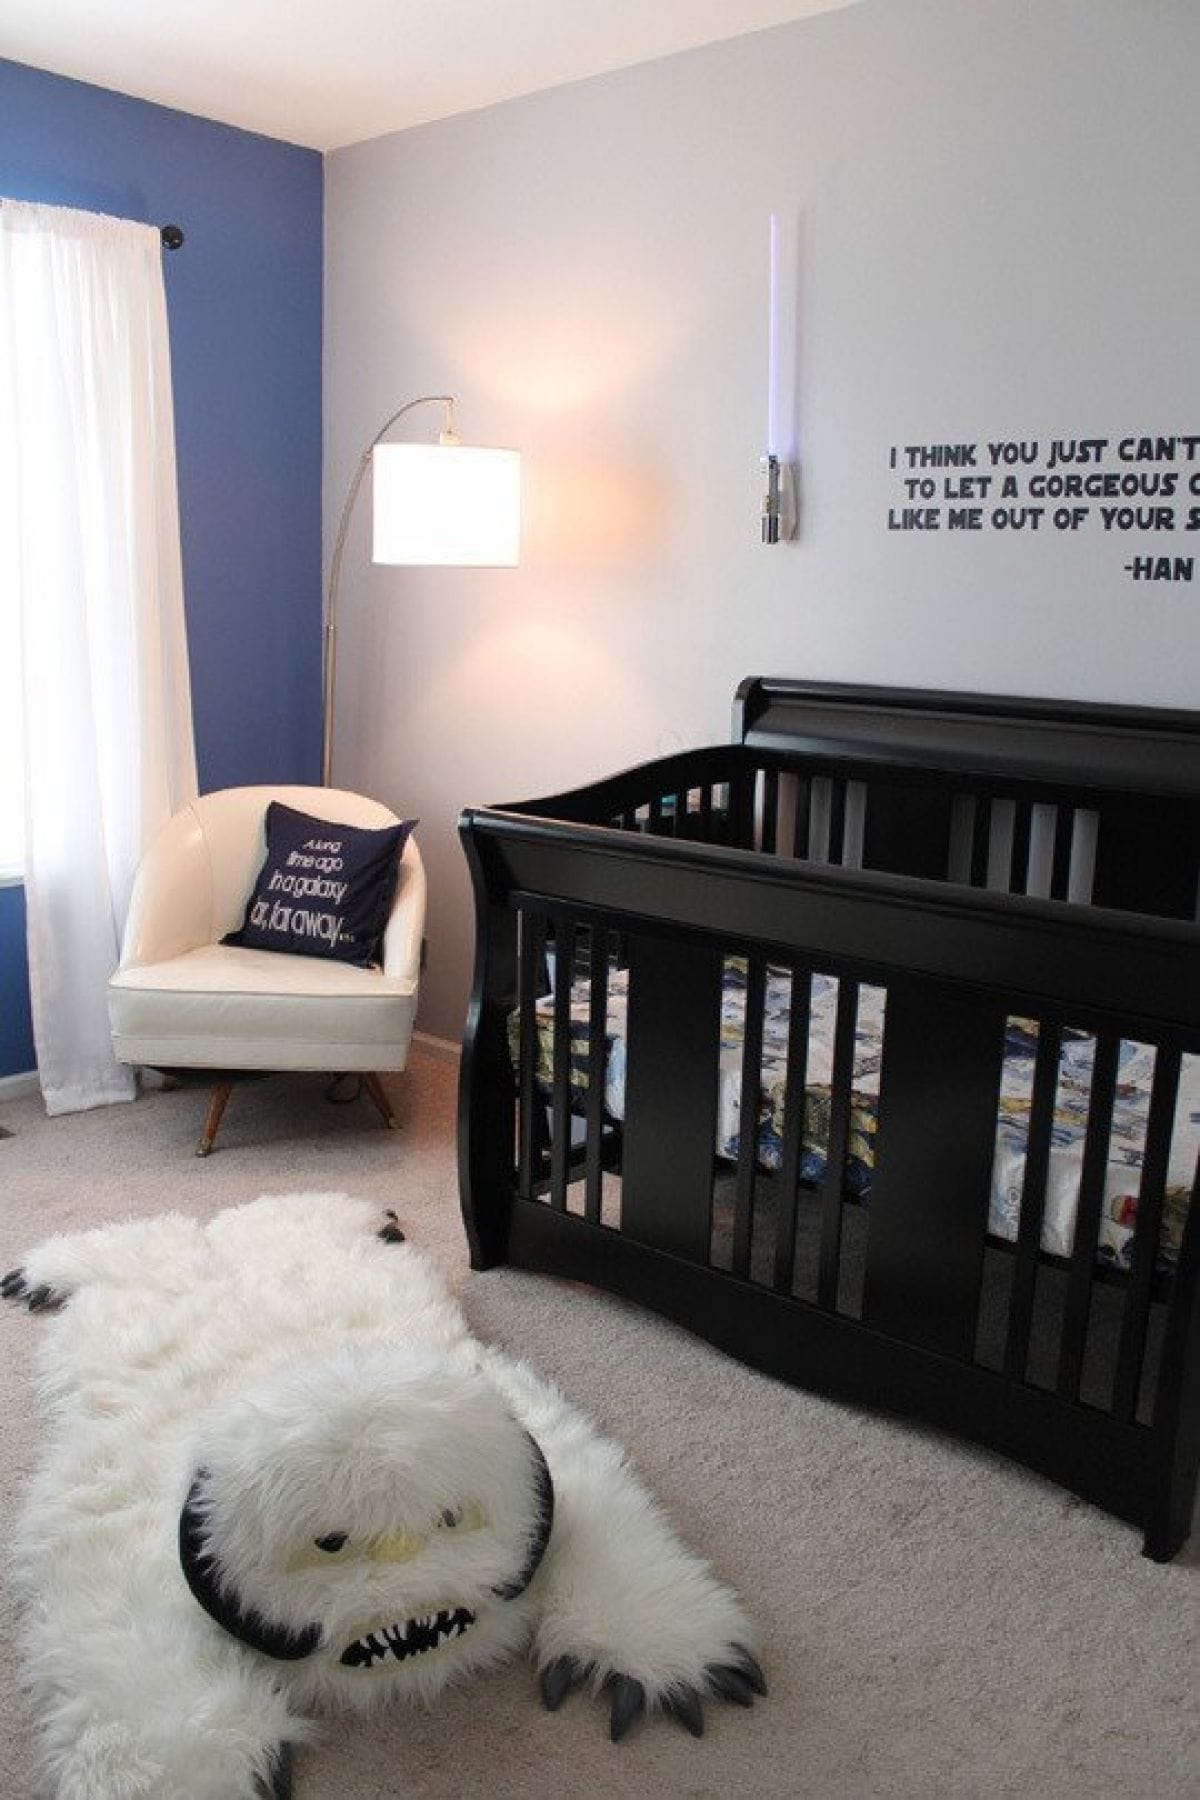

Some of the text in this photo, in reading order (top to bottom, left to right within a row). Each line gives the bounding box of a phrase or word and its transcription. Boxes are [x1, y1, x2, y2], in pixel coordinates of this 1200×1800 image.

[890, 435, 1200, 469] I THINK YOU JUST CAN'T
[904, 478, 936, 499] TO
[944, 475, 992, 498] LET
[1001, 475, 1019, 498] A
[1028, 472, 1179, 498] GORGEOUS
[888, 508, 940, 529] LIKE
[948, 508, 983, 529] ME
[991, 508, 1045, 529] OUT
[1053, 507, 1089, 529] OF
[1100, 507, 1174, 530] YOUR
[1124, 556, 1194, 581] -HAN
[315, 857, 344, 873] ago
[293, 875, 348, 905] galaxy
